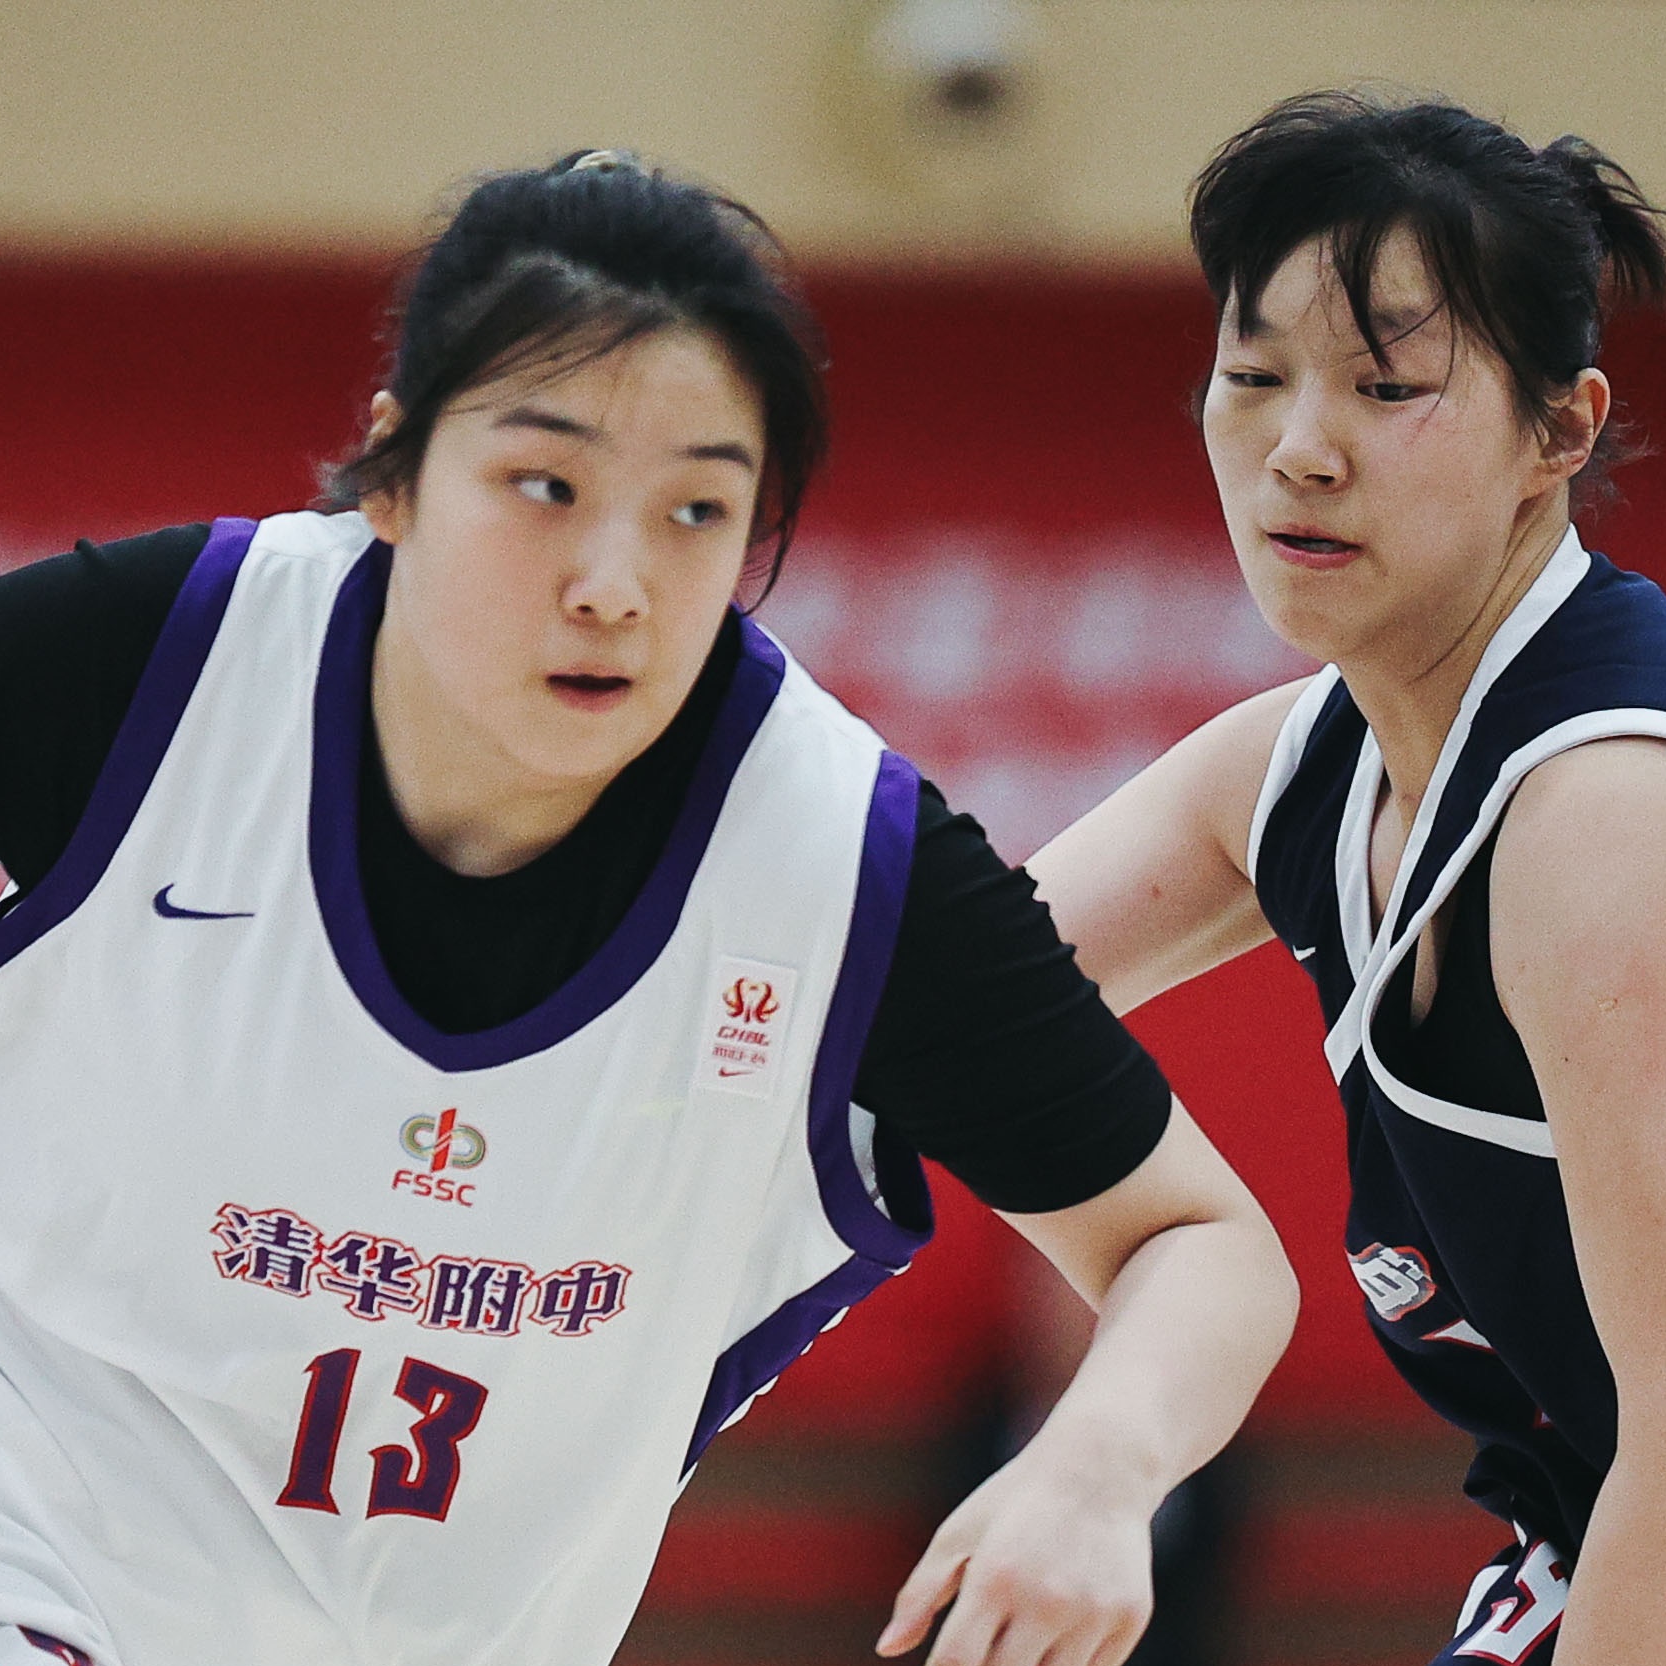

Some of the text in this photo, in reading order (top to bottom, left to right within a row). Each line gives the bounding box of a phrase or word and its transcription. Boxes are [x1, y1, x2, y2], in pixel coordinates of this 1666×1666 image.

[392, 1169, 476, 1207] FSSC
[210, 1203, 632, 1337] 清华附中
[275, 1347, 489, 1523] 13
